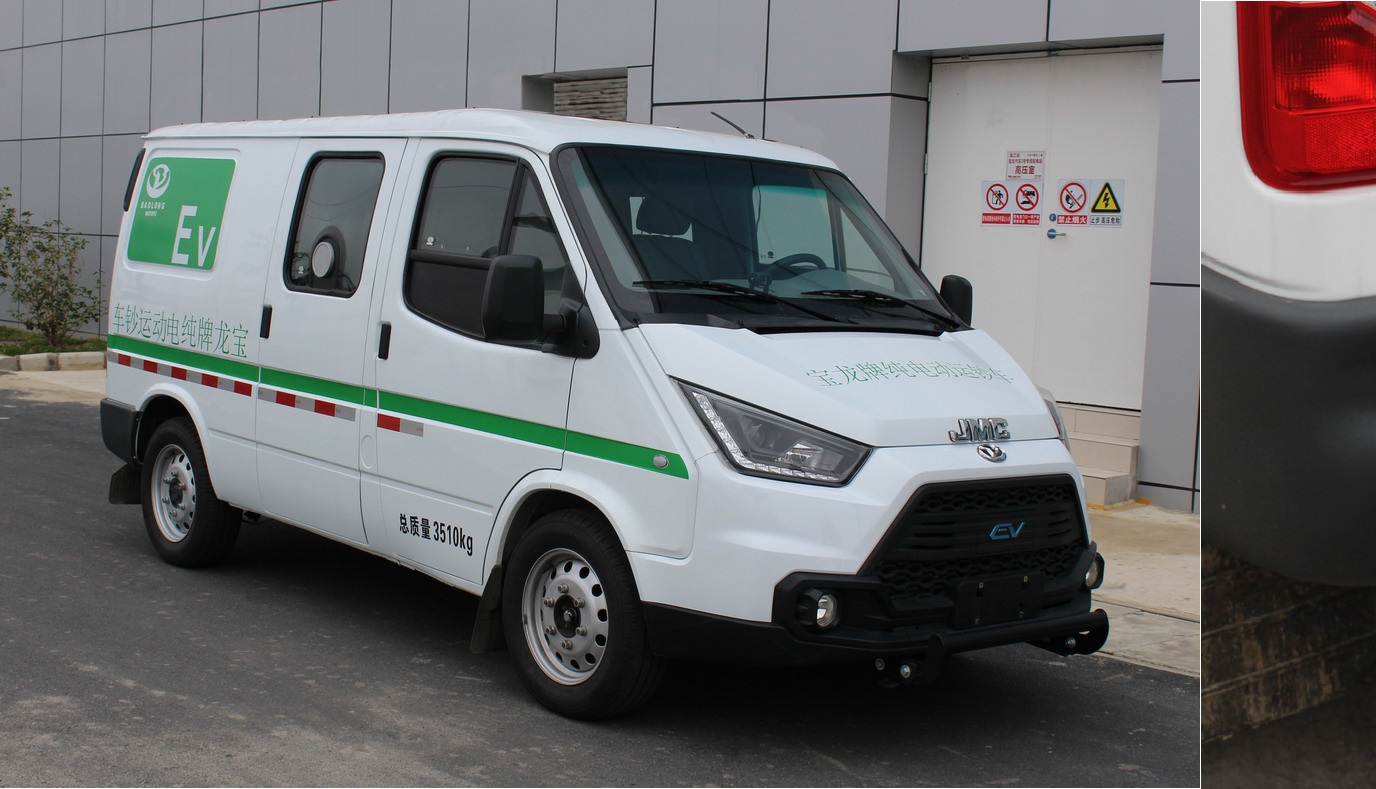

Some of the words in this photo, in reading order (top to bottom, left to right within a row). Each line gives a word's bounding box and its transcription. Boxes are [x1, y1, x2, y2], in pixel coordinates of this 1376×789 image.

[140, 201, 166, 210] BAOLONG
[1058, 215, 1087, 224] 禁止烟火
[806, 360, 1014, 387] 宝龙牌纯电动运钞车
[948, 417, 1012, 443] JMC
[990, 520, 1025, 540] EV
